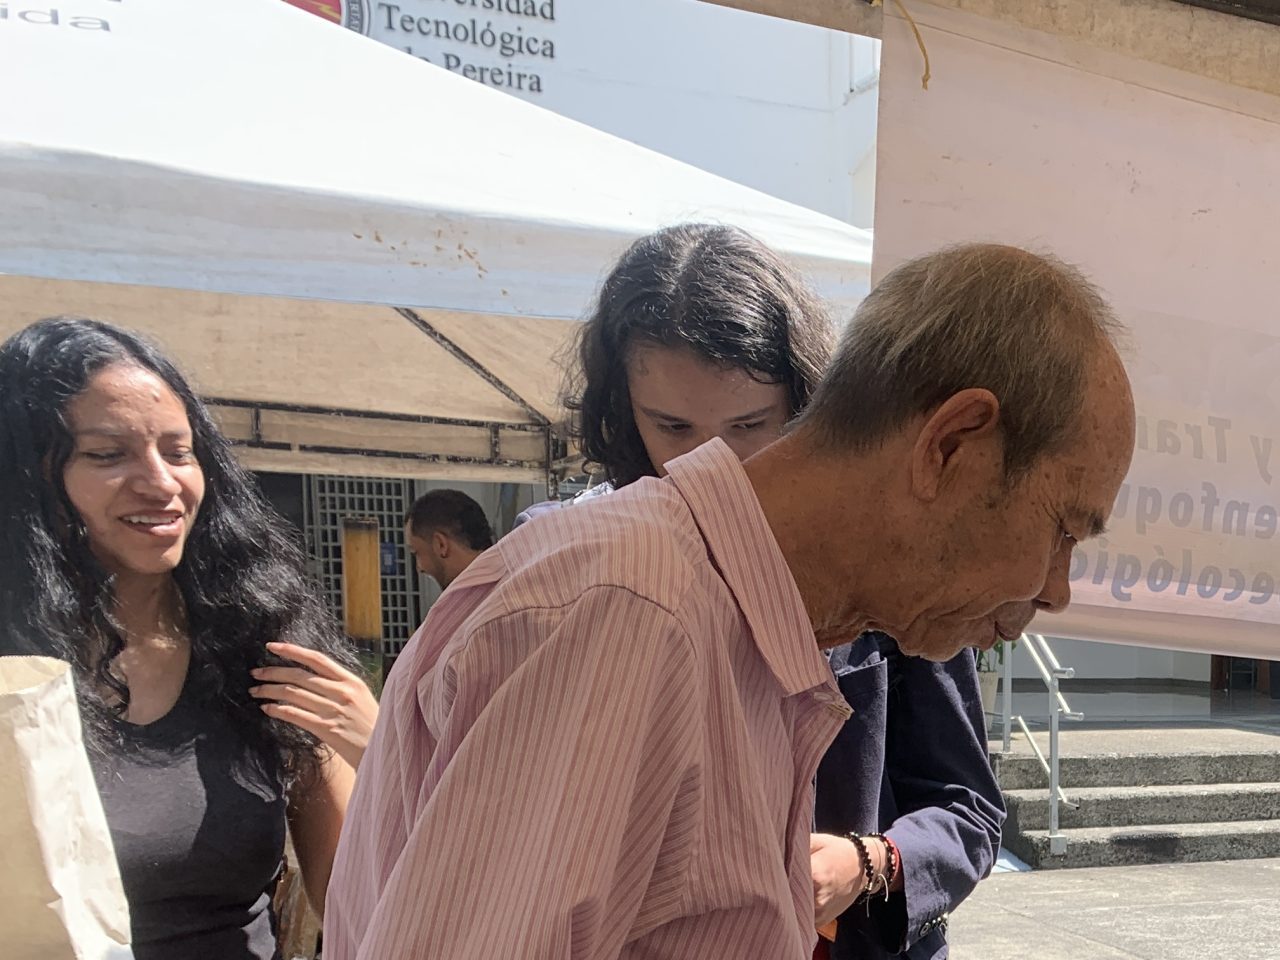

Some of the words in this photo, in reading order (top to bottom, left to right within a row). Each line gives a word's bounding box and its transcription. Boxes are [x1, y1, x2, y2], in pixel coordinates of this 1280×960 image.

[0, 2, 111, 32] ida
[378, 2, 555, 59] Tecnológica
[442, 52, 542, 93] Pereira
